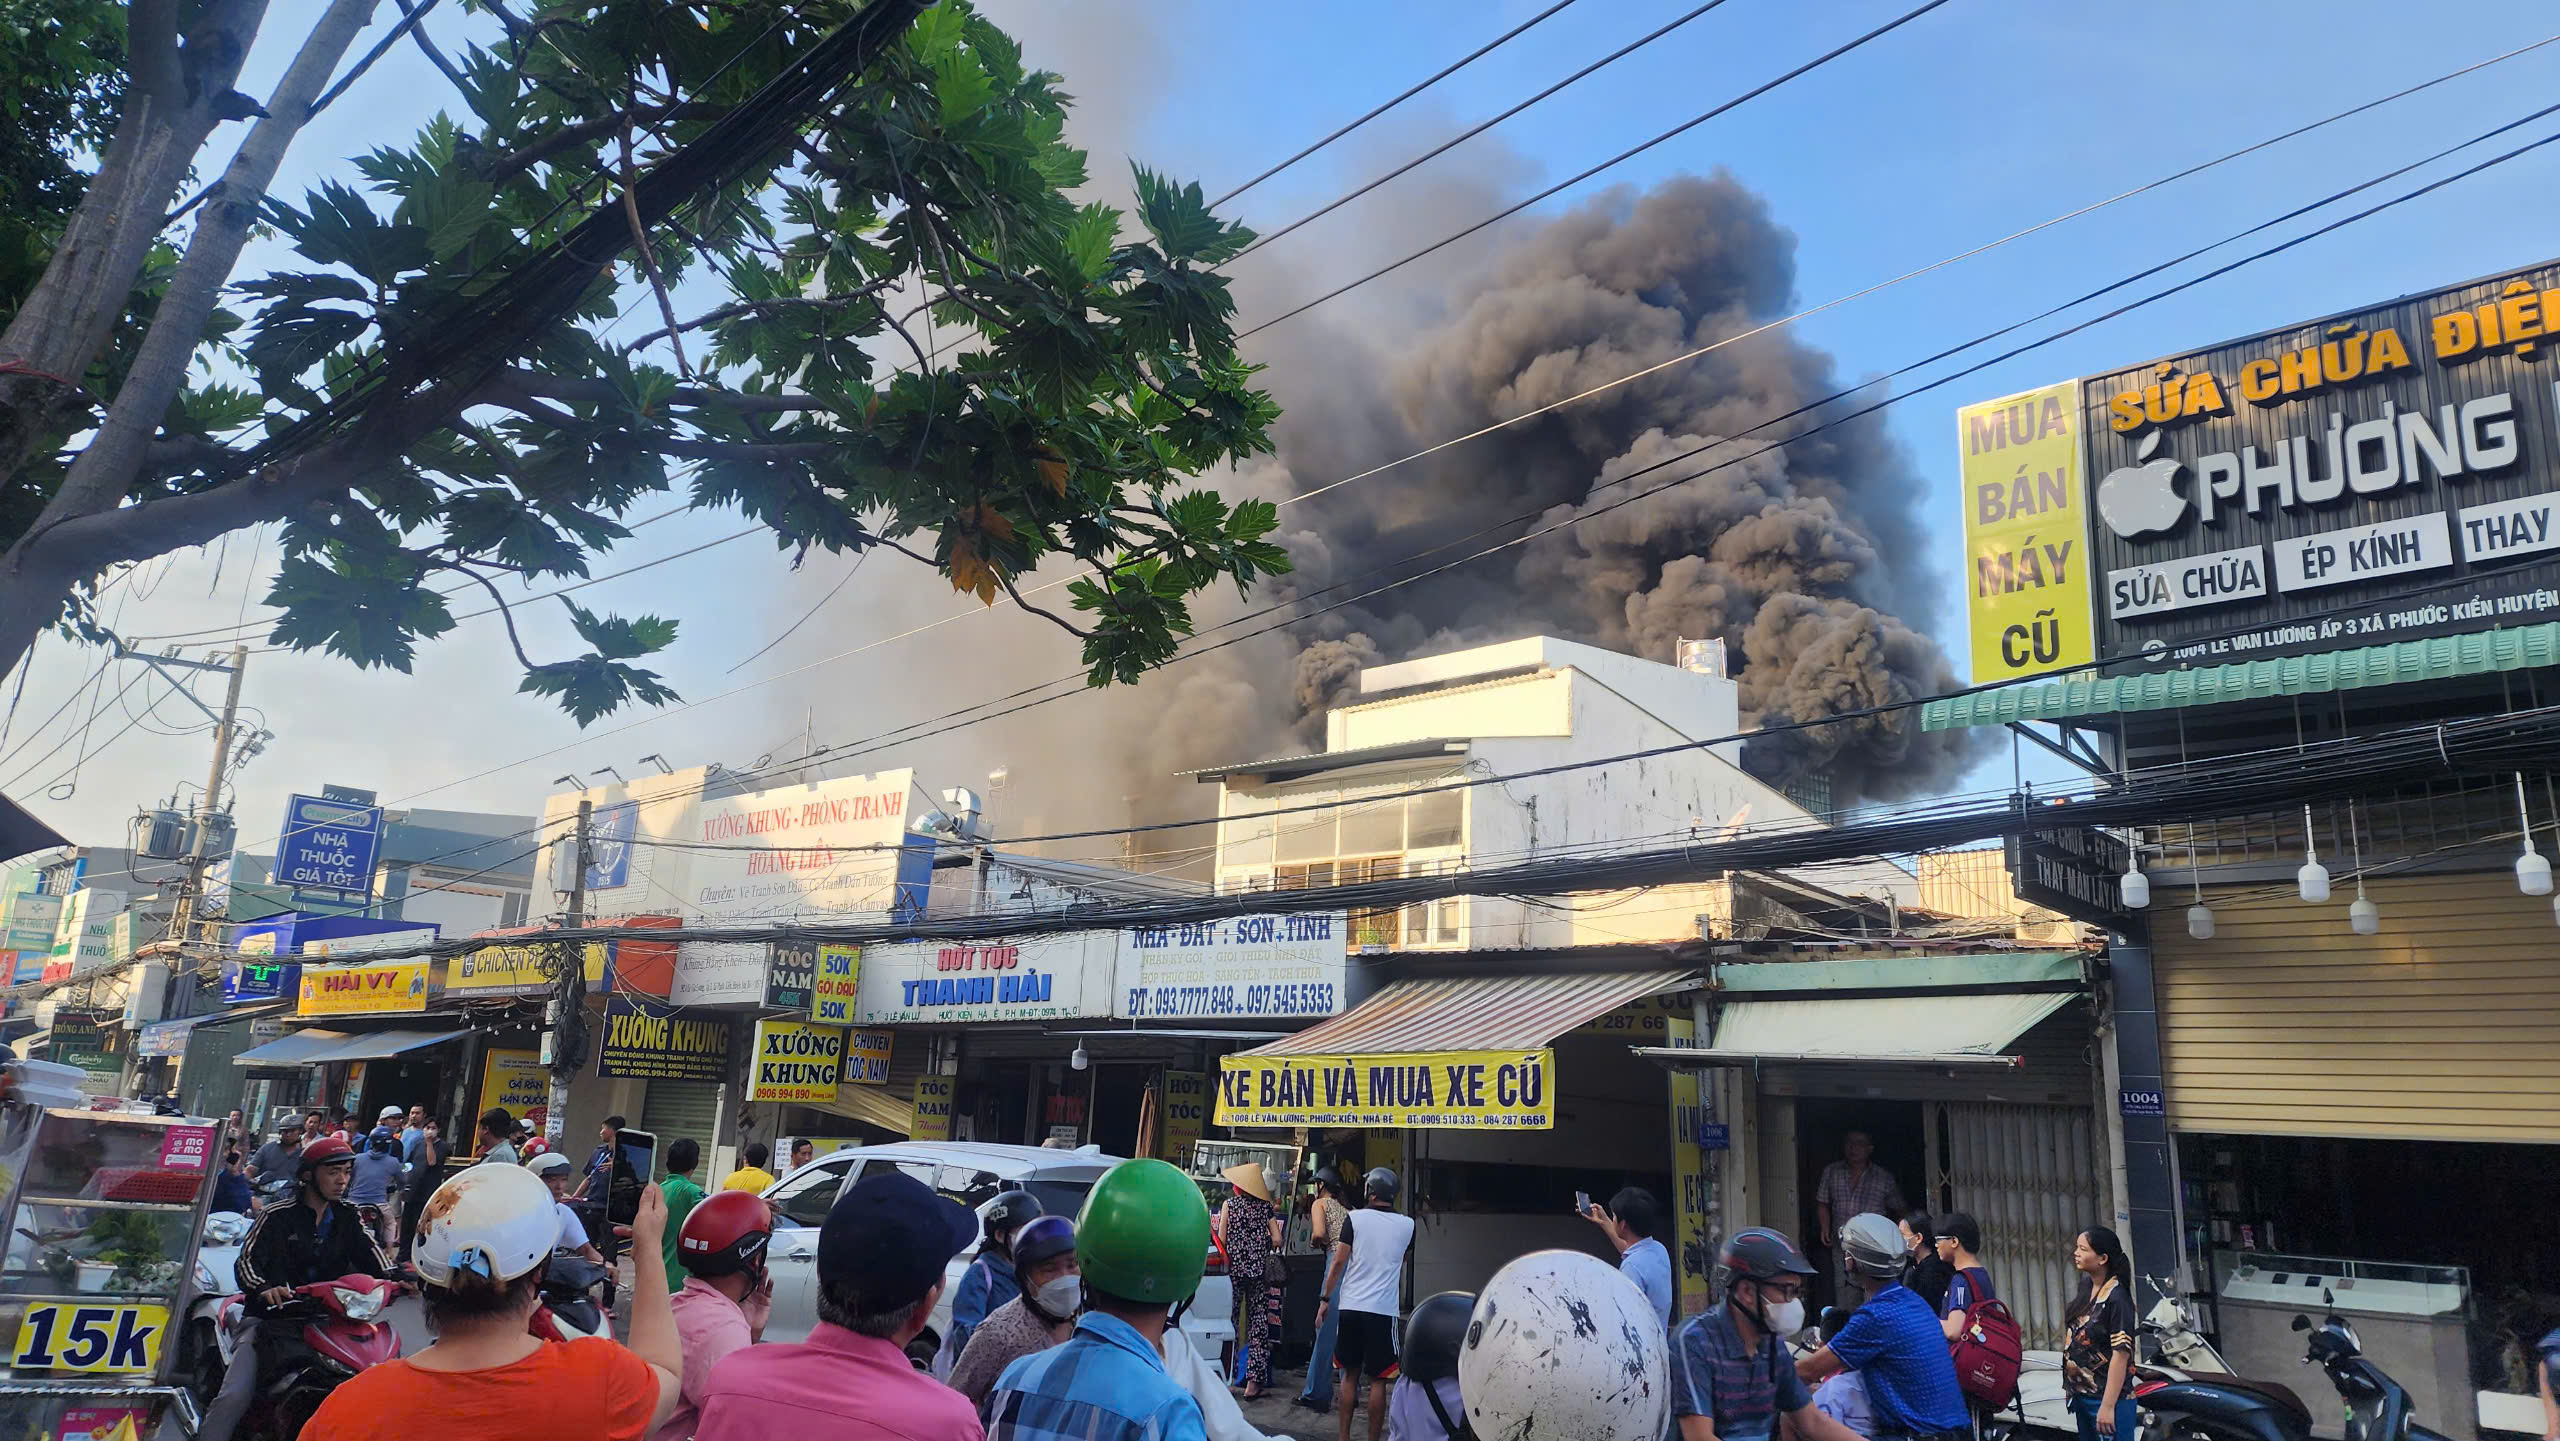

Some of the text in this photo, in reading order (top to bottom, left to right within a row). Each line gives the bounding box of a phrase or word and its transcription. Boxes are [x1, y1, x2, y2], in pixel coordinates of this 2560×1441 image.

[2110, 361, 2225, 432] SỬA
[2240, 321, 2411, 402] CHỮA
[1970, 396, 2067, 456] MUA
[2200, 392, 2518, 522] PHƯƠNG
[1977, 463, 2068, 525] BÁN
[2466, 507, 2551, 553] THAY
[1977, 535, 2073, 598] MÁY
[2301, 529, 2422, 580] ÉP KÍNH
[2114, 556, 2262, 611] SỬA CHỮA
[2264, 625, 2322, 647] LƯƠNG
[2321, 617, 2343, 639] ẤP
[2346, 619, 2357, 635] 3
[2360, 612, 2385, 634] XÃ
[2389, 604, 2449, 630] PHƯỚC
[2497, 588, 2560, 614] HUYỆN
[2001, 607, 2060, 668] CŨ
[746, 806, 792, 835] KHUNG
[801, 794, 849, 828] PHÒNG
[853, 791, 905, 821] TRANH
[312, 831, 349, 848] NHÀ
[300, 847, 356, 868] THUỐC
[747, 836, 835, 876] HOÀNG LIÊN
[293, 866, 356, 886] GIÁ TỐT
[2036, 854, 2063, 892] THAY
[1236, 917, 1274, 945] SƠN
[477, 951, 526, 974] CHICKEN
[826, 955, 852, 975] 50K
[324, 969, 399, 992] HẢI VY
[771, 970, 813, 990] NAM
[902, 968, 1053, 1007] THANH HẢI
[779, 991, 801, 1006] 45K
[820, 1001, 846, 1019] 50K
[1155, 984, 1234, 1015] 093.7777.848
[1247, 982, 1334, 1013] 097.545.5353
[607, 1004, 729, 1054] XƯỞNG KHUNG
[1603, 1015, 1635, 1029] 287
[765, 1026, 839, 1056] XƯỞNG
[68, 1053, 102, 1066] Carlsberg
[867, 1059, 889, 1081] NAM
[630, 1068, 682, 1078] 0906.994.890
[760, 1063, 835, 1085] KHUNG
[1222, 1055, 1541, 1108] XE BÁN VÀ MUA XE CŨ
[757, 1088, 810, 1099] 0906 994 890
[920, 1079, 949, 1096] TÓC
[2122, 1093, 2160, 1104] 1004
[917, 1102, 949, 1116] NAM
[1169, 1100, 1201, 1119] TÓC
[1231, 1114, 1249, 1123] 1008
[1362, 1113, 1380, 1124] NHÀ
[1421, 1114, 1440, 1124] 0909
[1442, 1114, 1458, 1124] 510
[1460, 1114, 1476, 1124] 333
[1484, 1114, 1499, 1124] 084
[1502, 1114, 1518, 1125] 287
[1520, 1115, 1546, 1126] 6668
[17, 1307, 157, 1367] 15k
